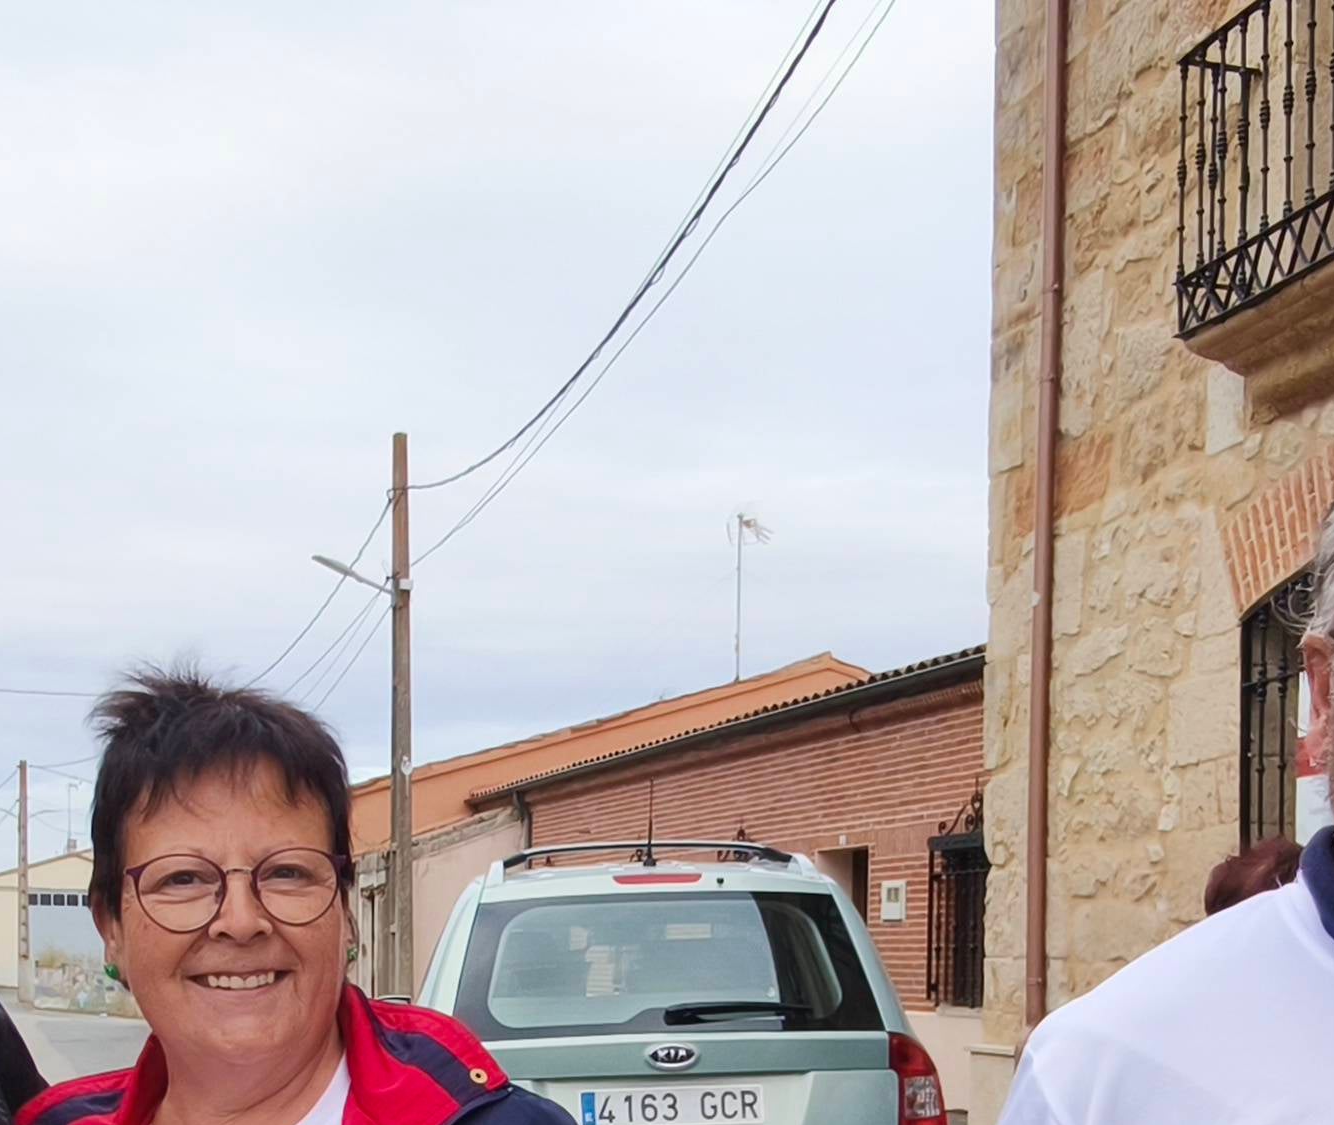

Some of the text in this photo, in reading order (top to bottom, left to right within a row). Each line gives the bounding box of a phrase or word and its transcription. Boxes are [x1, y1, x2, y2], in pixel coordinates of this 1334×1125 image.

[656, 1048, 688, 1061] KIA
[598, 1090, 759, 1124] 4163 GCR
